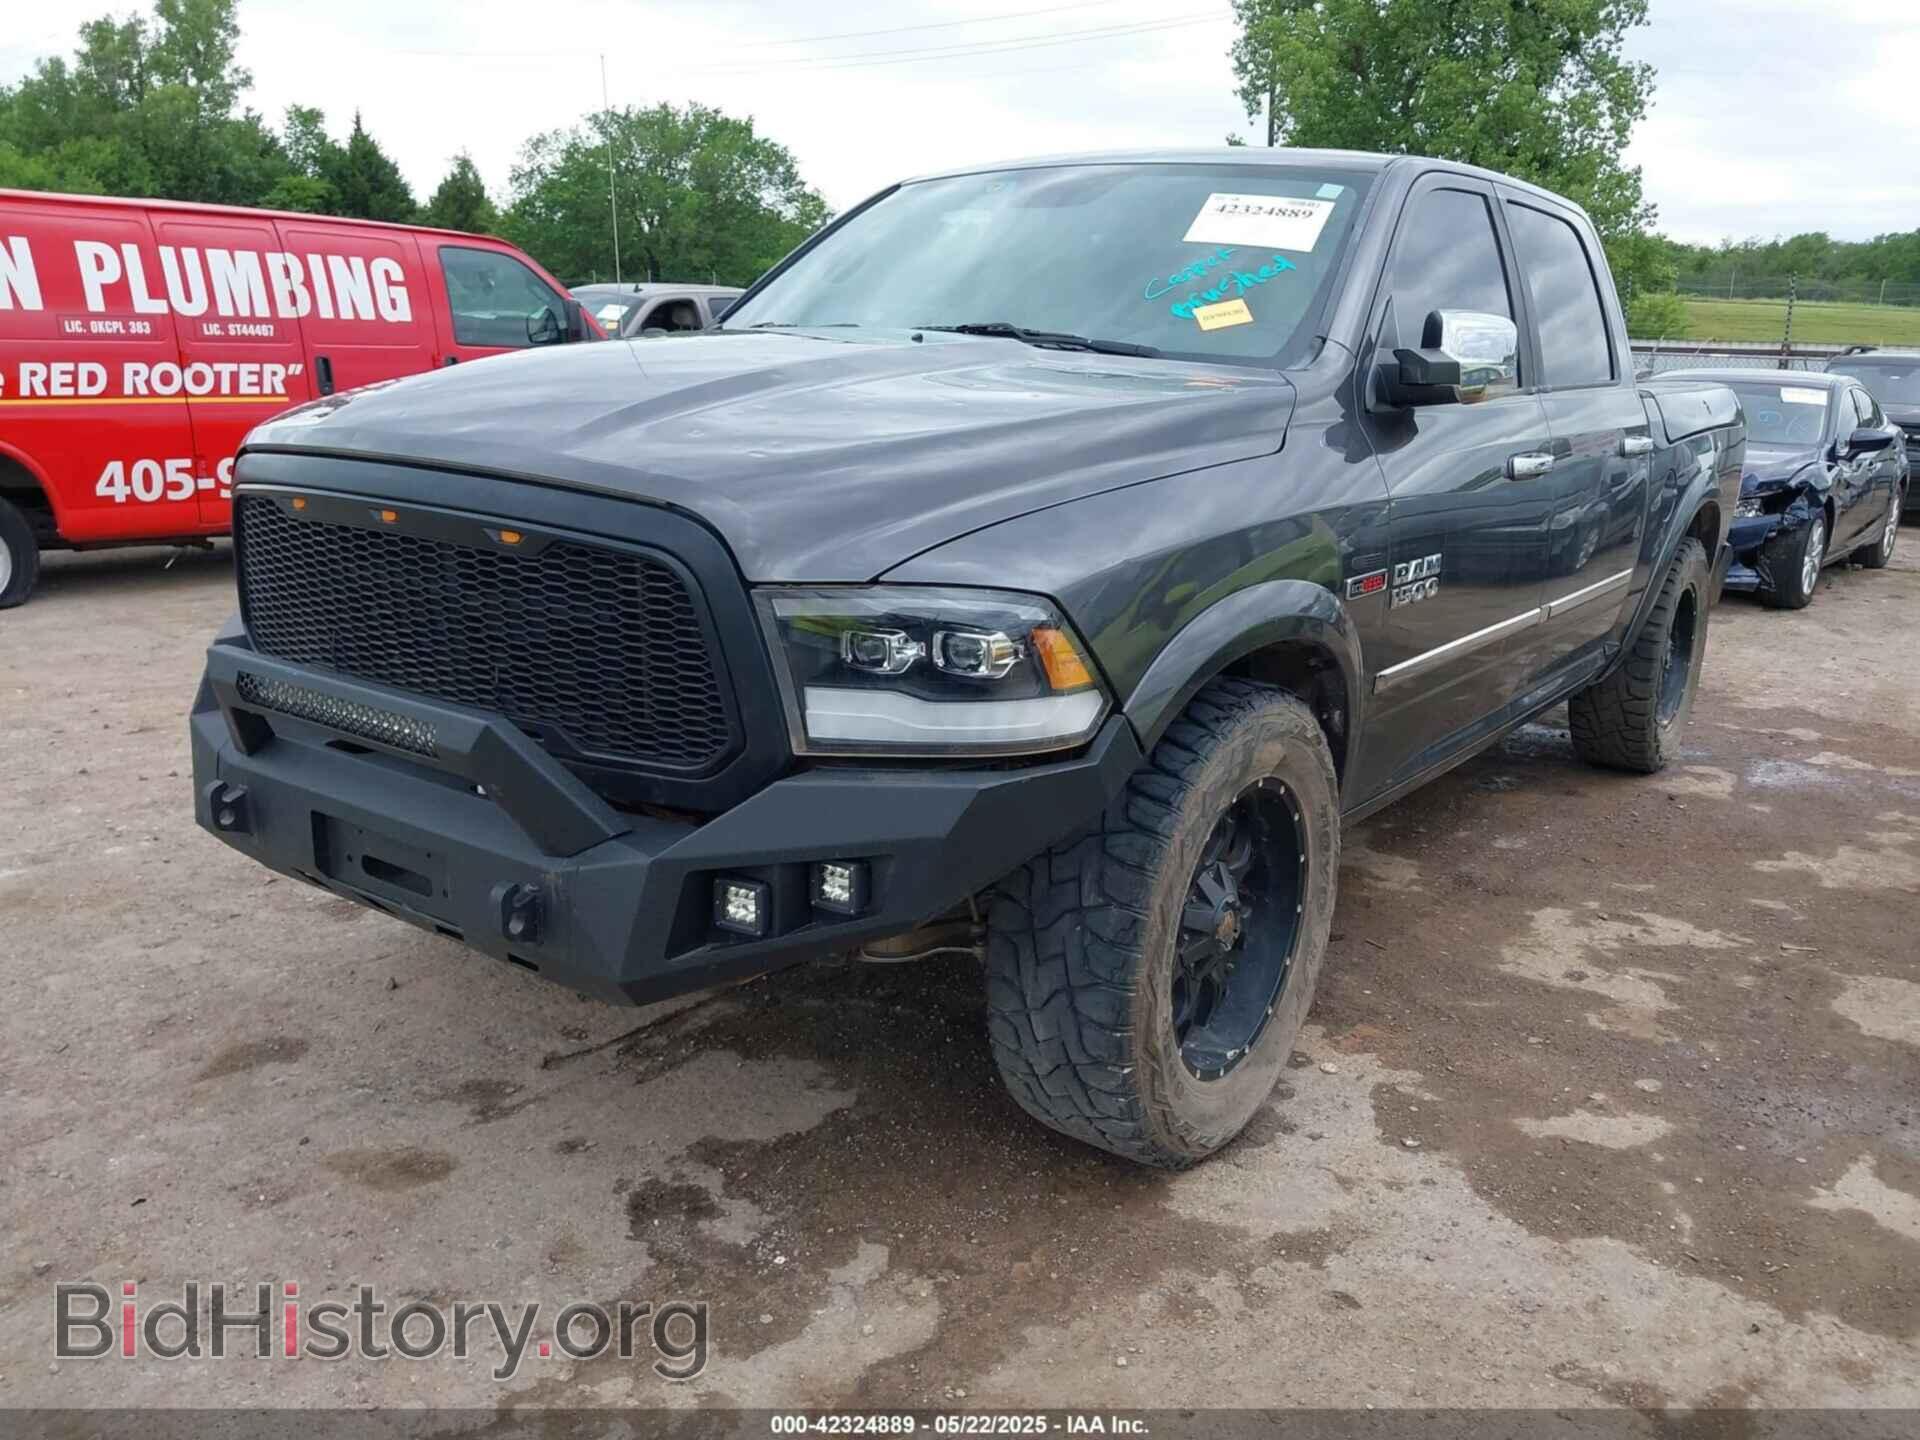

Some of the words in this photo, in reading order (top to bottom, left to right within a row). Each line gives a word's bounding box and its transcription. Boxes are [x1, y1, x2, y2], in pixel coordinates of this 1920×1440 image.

[1214, 203, 1314, 219] 42324889
[73, 239, 413, 323] PLUMBING
[64, 320, 87, 333] LIC.
[202, 322, 225, 336] LIC.
[19, 362, 108, 397] RED
[1393, 553, 1442, 585] RAM
[1390, 576, 1440, 609] 1500
